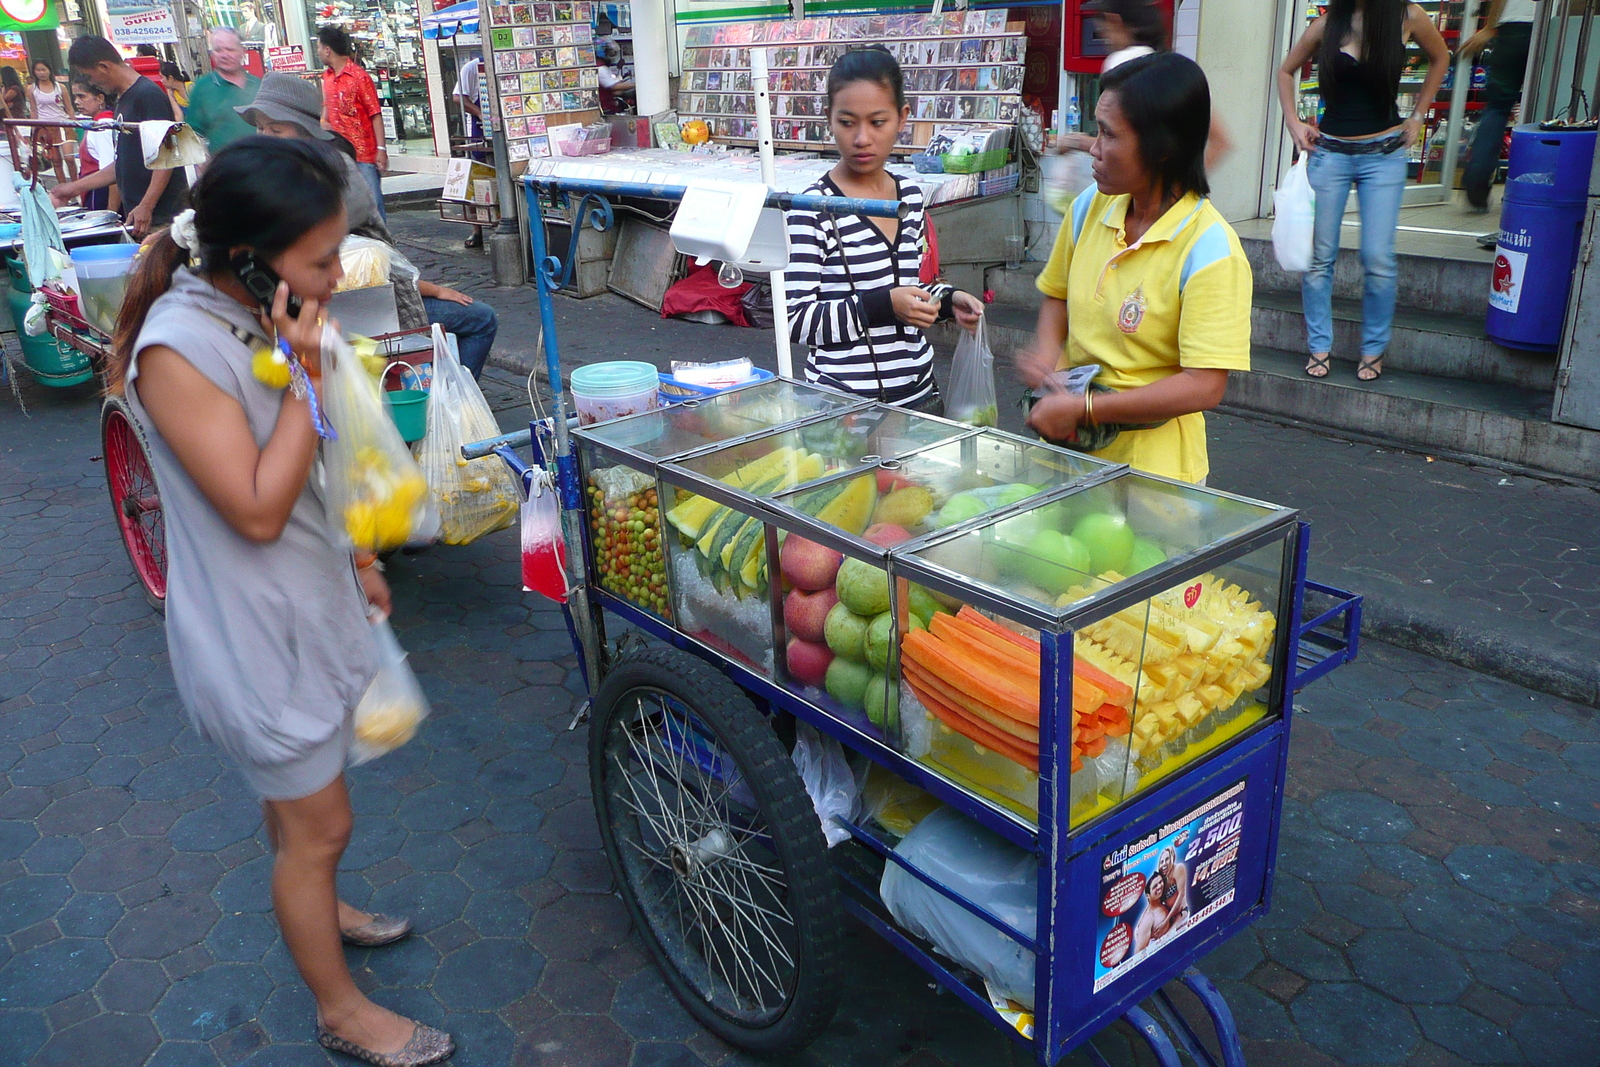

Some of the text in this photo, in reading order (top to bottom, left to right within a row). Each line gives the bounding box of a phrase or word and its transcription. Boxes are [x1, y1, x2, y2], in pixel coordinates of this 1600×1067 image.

[124, 14, 167, 26] OUTLET
[114, 27, 173, 36] 038-425624-5
[498, 33, 508, 41] DJ
[271, 54, 304, 67] SPECIAL DISCOUNT
